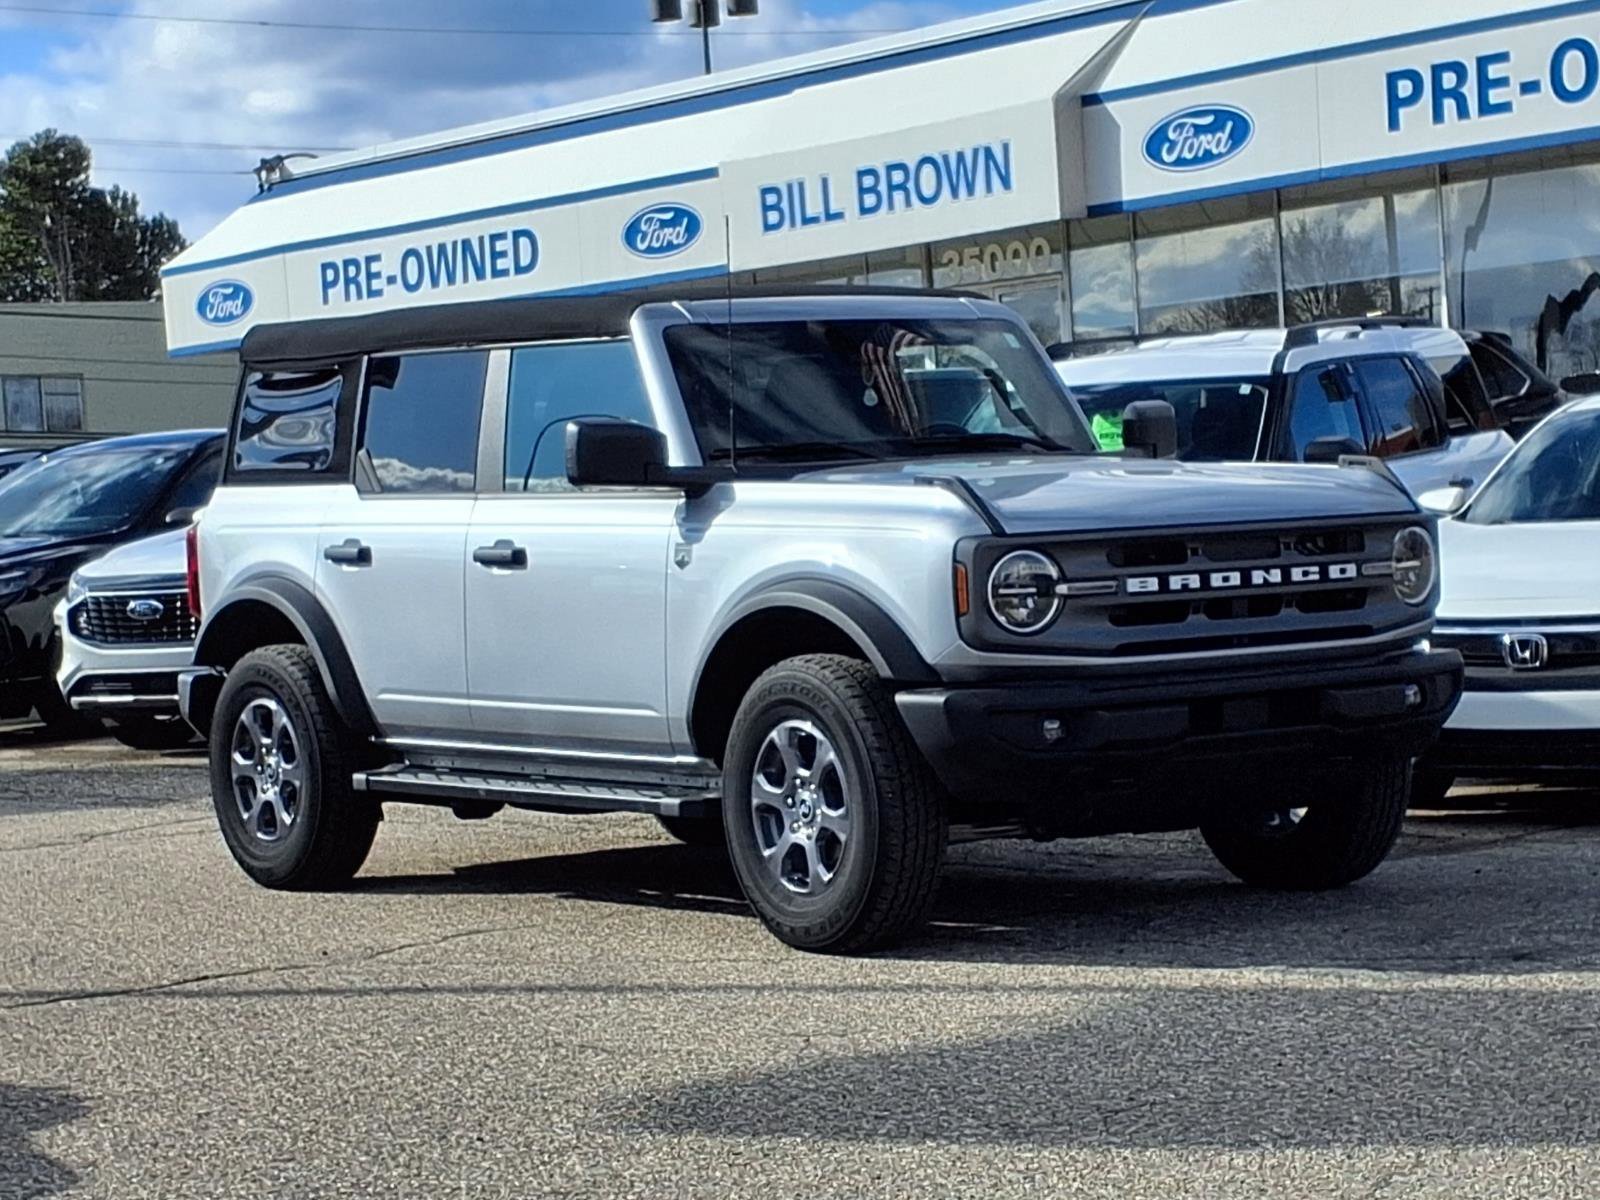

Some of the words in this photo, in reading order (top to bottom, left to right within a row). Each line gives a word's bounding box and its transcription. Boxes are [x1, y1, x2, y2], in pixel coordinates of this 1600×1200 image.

[1160, 113, 1233, 164] Ford
[760, 176, 845, 234] BILL
[856, 141, 1013, 217] BROWN
[636, 211, 688, 251] Ford
[320, 228, 539, 306] PRE-OWNED
[205, 286, 244, 319] Ford
[1126, 563, 1357, 593] BRONCO
